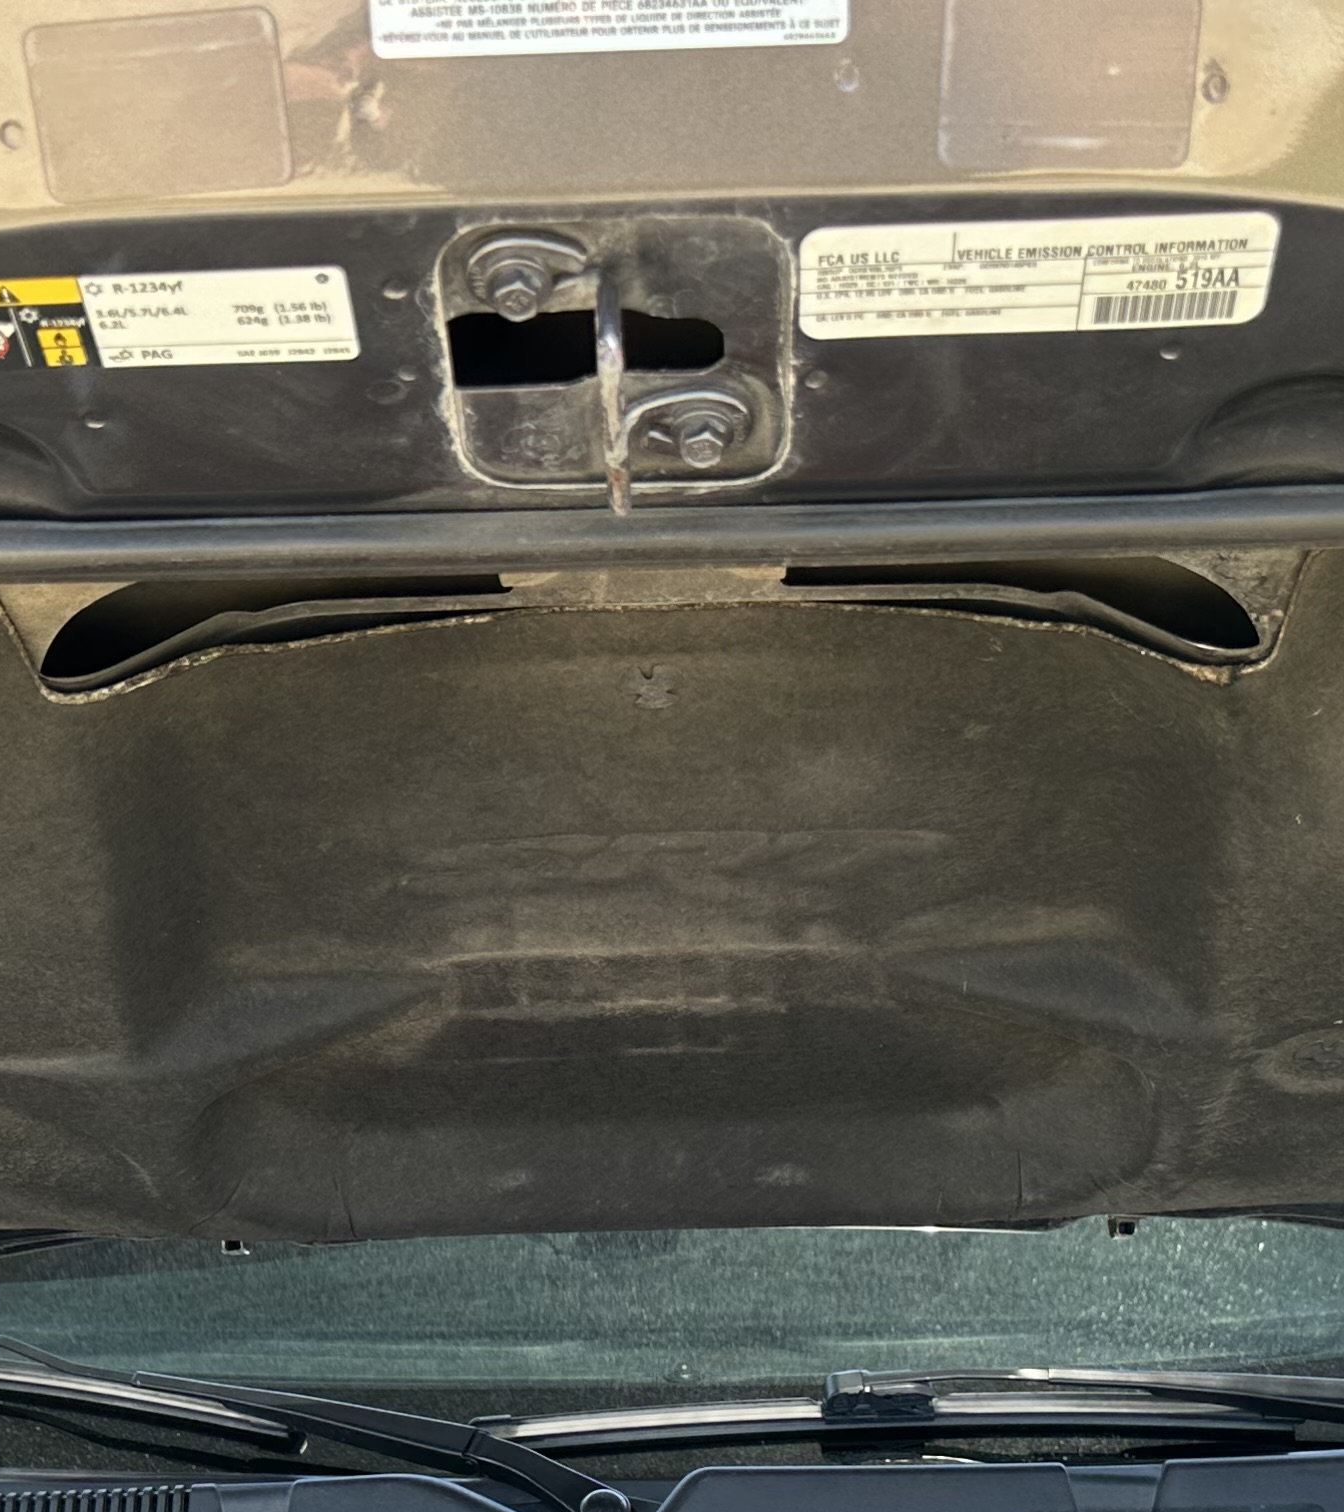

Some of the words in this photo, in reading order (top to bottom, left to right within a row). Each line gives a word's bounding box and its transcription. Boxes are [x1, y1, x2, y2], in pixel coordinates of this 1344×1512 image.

[582, 1, 596, 12] DE
[509, 30, 521, 40] DE
[591, 26, 617, 37] POUR
[662, 24, 686, 35] PLUS
[689, 24, 701, 34] DE
[818, 254, 845, 266] FCA
[850, 253, 869, 265] US
[874, 252, 900, 264] LLC
[957, 248, 1012, 261] VEHICLE
[1017, 246, 1083, 259] EMISSION
[1087, 242, 1147, 257] CONTROL
[1154, 238, 1248, 254] INFORMATION
[1127, 280, 1167, 291] 47480
[1175, 268, 1240, 290] 519AA
[112, 281, 183, 295] R-1234yf
[232, 304, 264, 315] 709g
[100, 321, 126, 330] 6.2L
[237, 316, 268, 326] 624g
[141, 350, 173, 360] PAG
